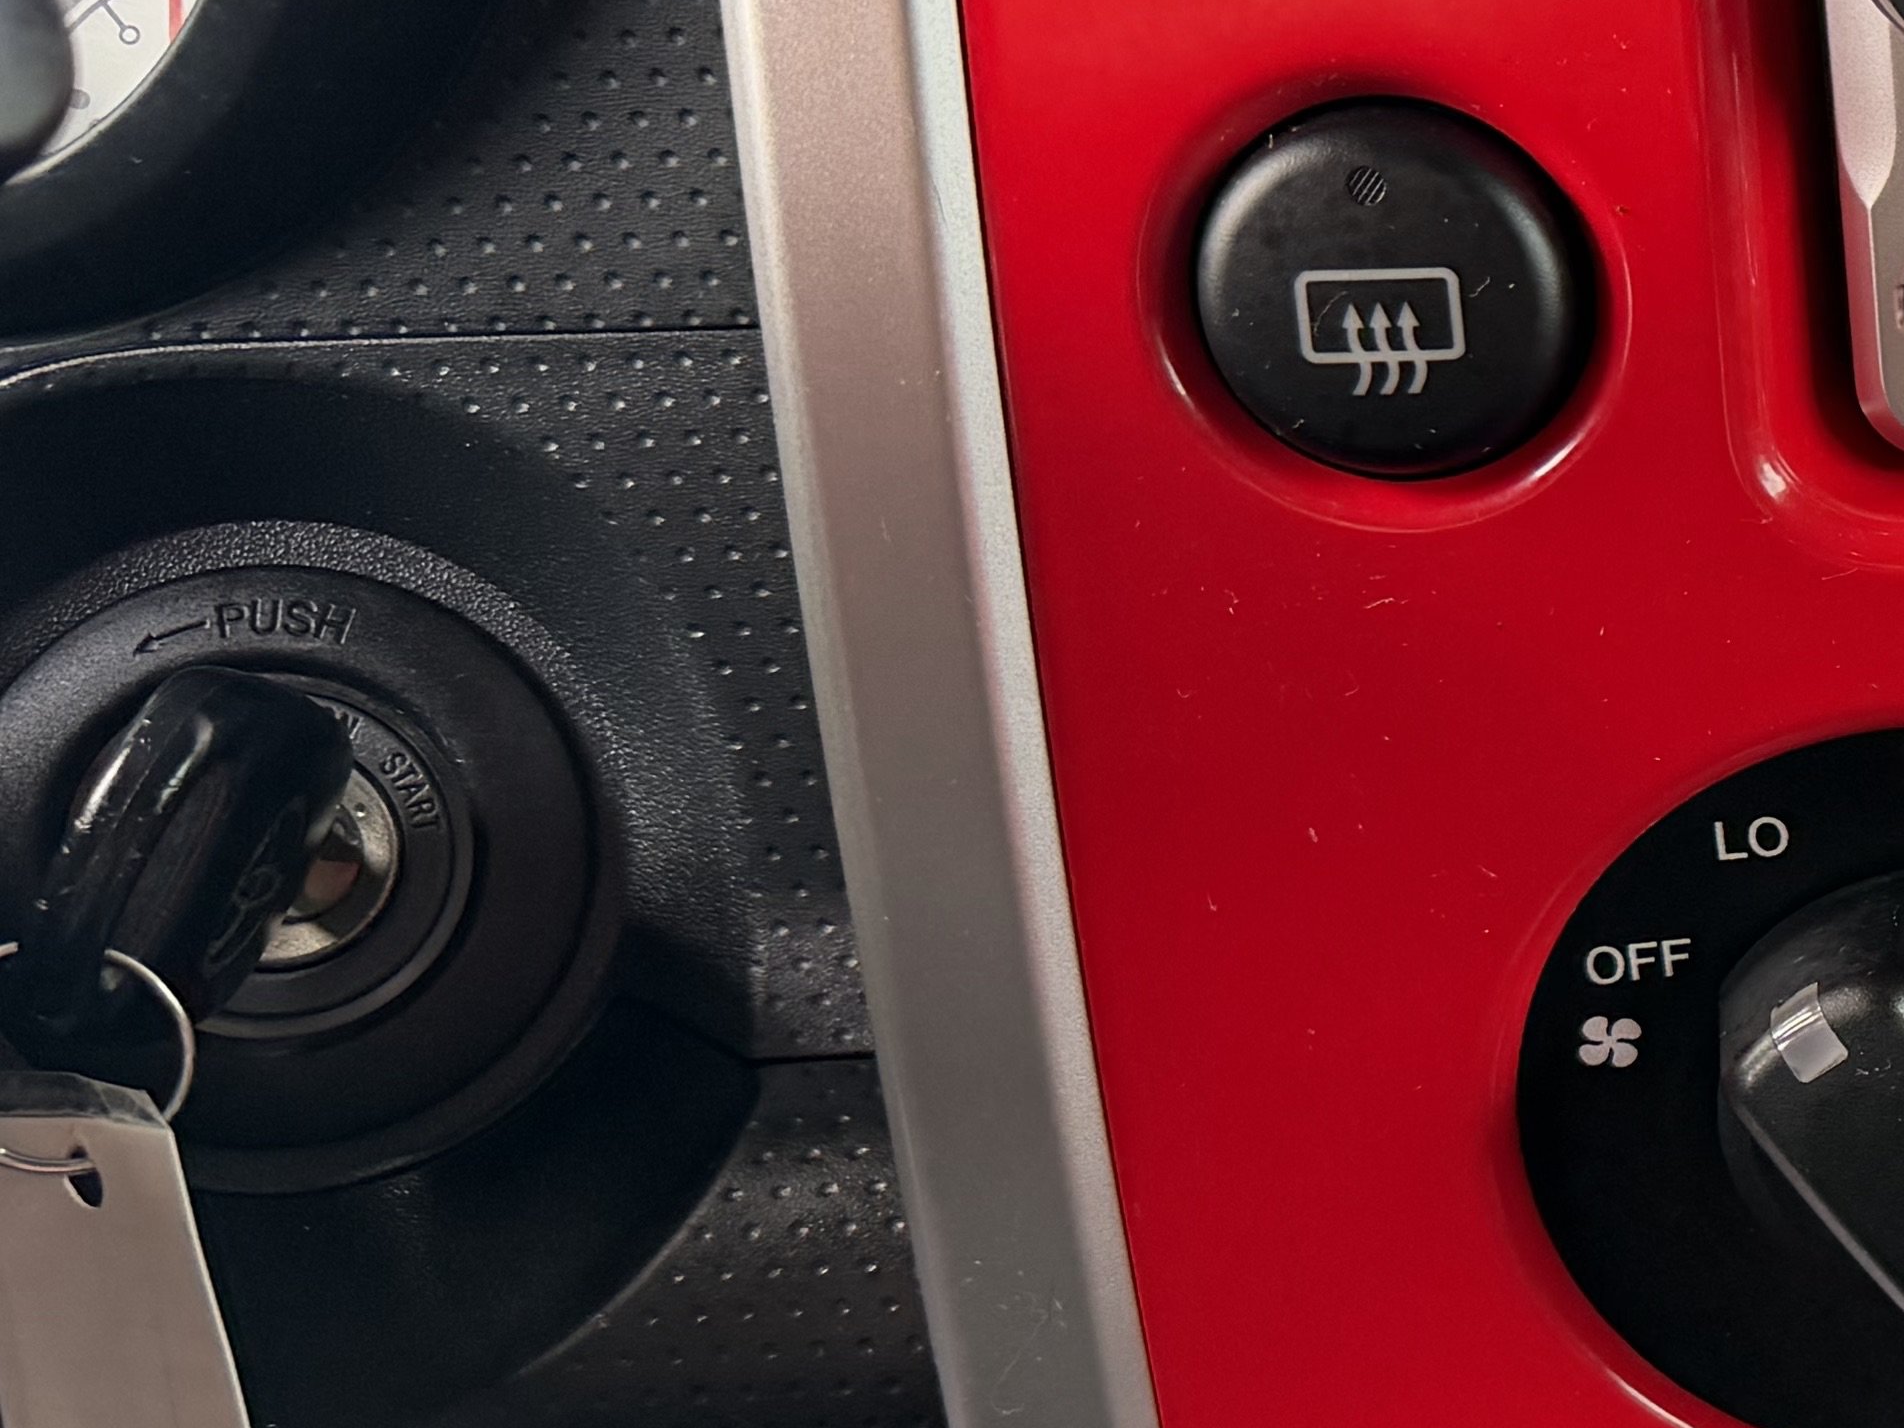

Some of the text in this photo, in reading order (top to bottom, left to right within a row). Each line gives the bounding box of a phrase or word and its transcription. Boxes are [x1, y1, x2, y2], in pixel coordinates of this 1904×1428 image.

[213, 598, 357, 645] PUSH
[378, 750, 442, 830] START
[1714, 816, 1789, 861] LO
[1585, 937, 1692, 985] OFF
